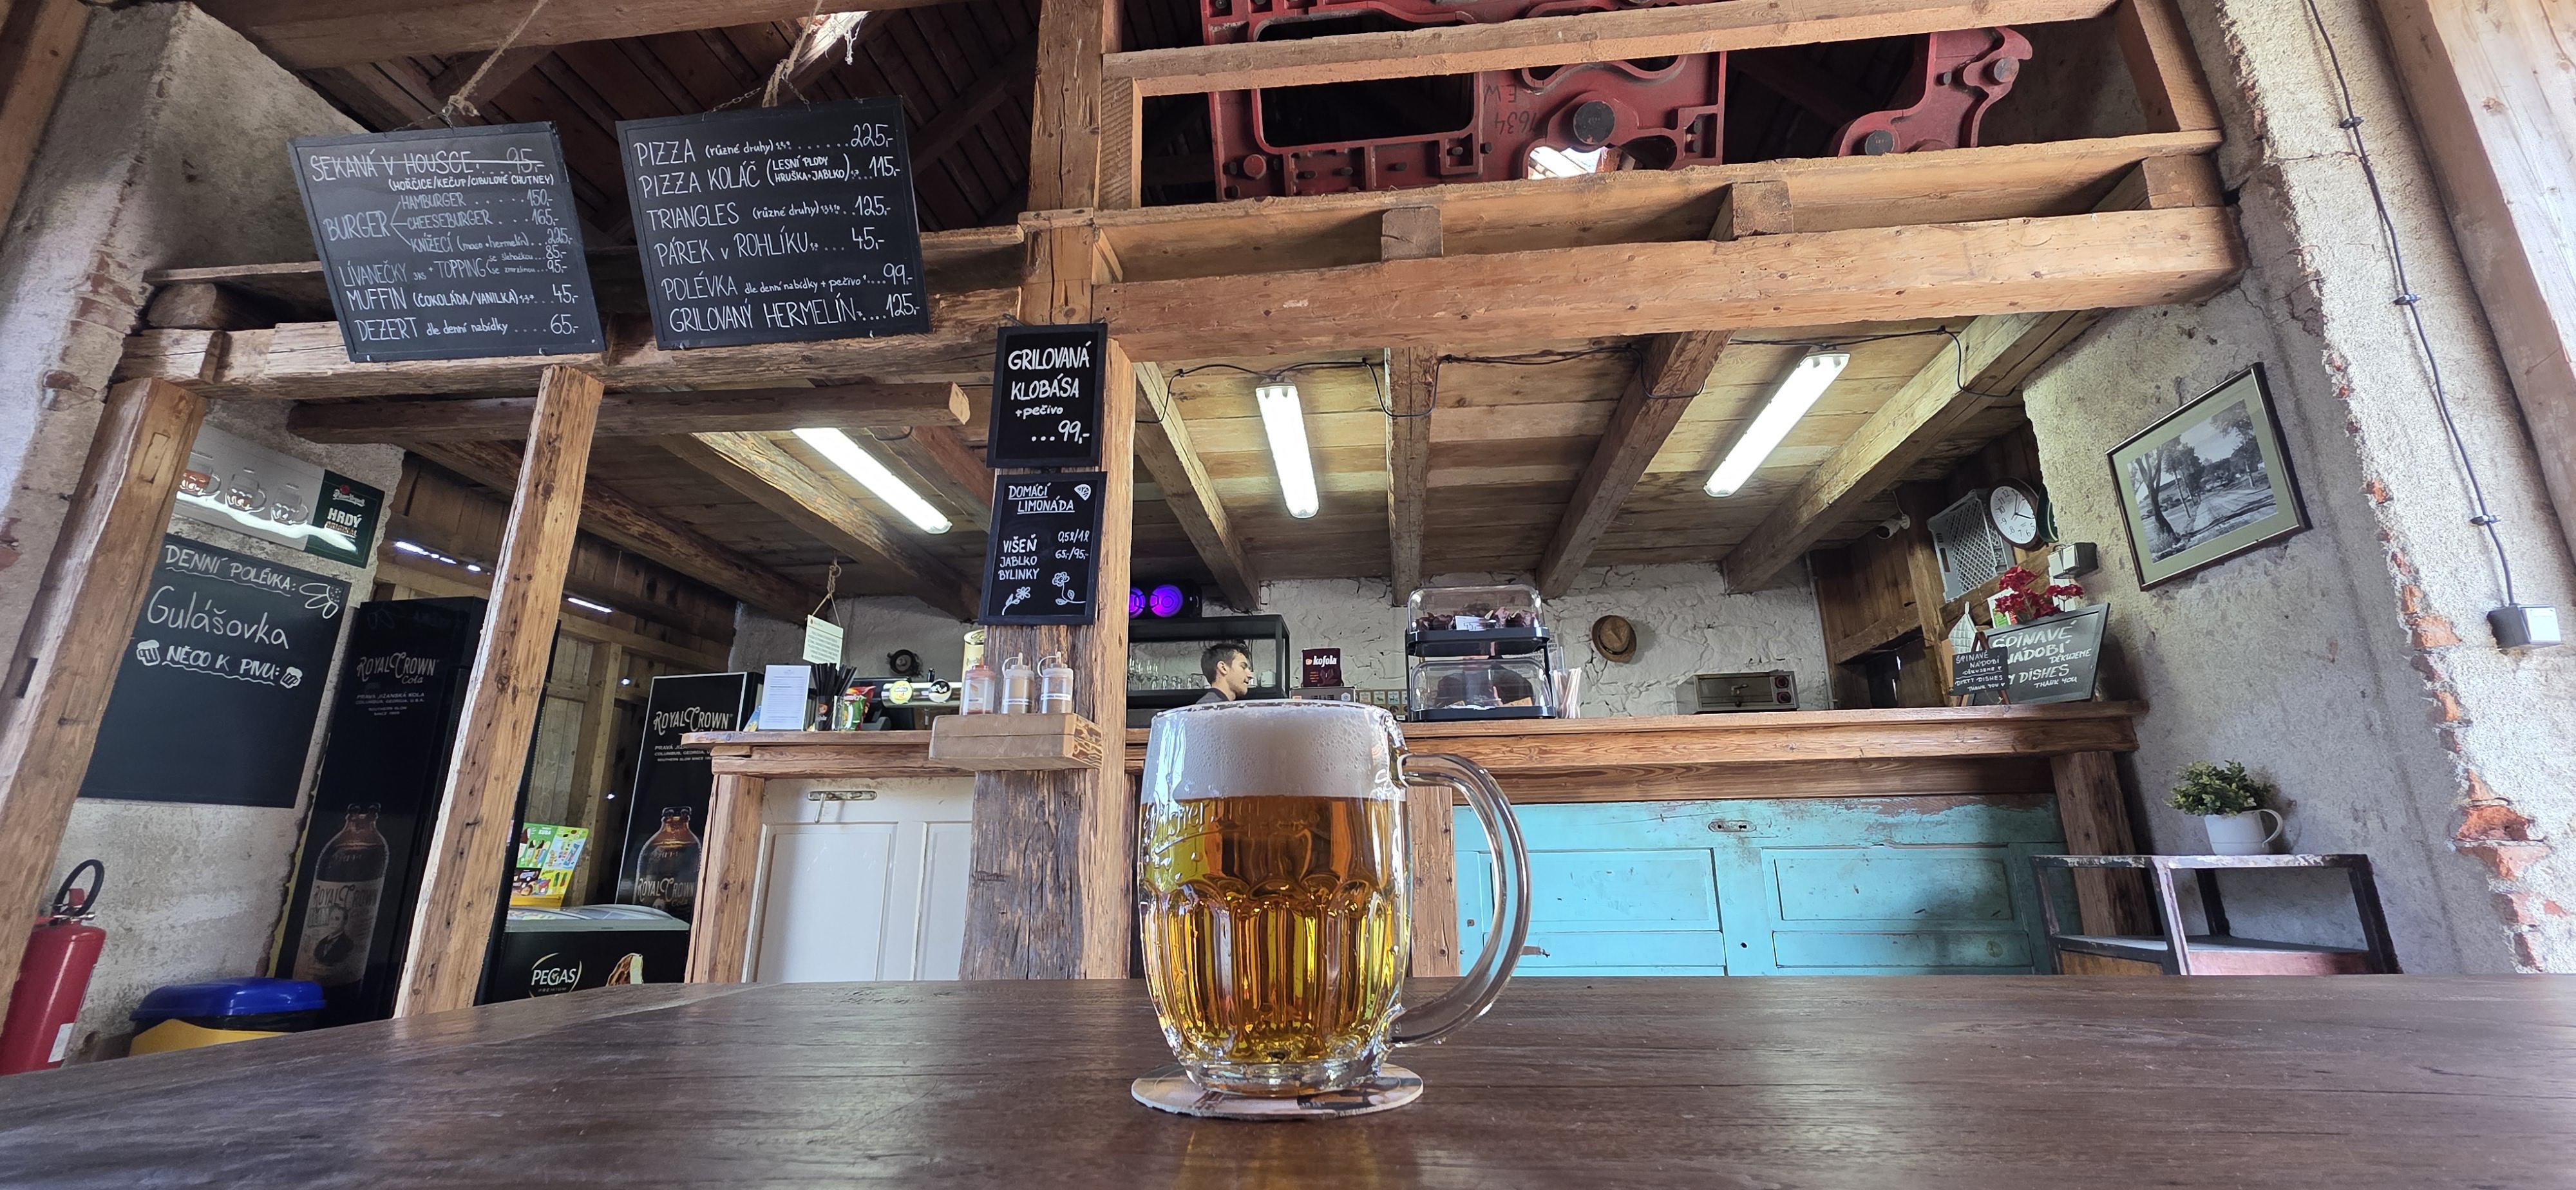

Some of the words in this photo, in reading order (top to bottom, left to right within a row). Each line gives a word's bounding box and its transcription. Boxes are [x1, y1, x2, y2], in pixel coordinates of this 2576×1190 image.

[634, 138, 696, 167] PIZZA
[705, 144, 740, 158] (různé
[743, 138, 773, 155] druhy)
[851, 123, 893, 147] 225,-
[310, 149, 378, 182] SEKANÁ
[381, 155, 393, 176] V
[404, 151, 473, 175] HOUSCE
[638, 171, 701, 198] PIZZA
[707, 160, 760, 191] KOLÁČ
[802, 156, 828, 167] PLODY
[869, 156, 900, 176] 115,-
[511, 174, 554, 185] CHUTNEY)
[401, 193, 466, 210] HAMBURGER
[527, 189, 553, 207] 150,-
[646, 202, 739, 231] TRIANGLES
[752, 206, 786, 220] (různé
[788, 200, 819, 216] druhy)
[855, 195, 891, 216] 125,-
[323, 211, 390, 241] BURGER
[407, 209, 493, 230] CHEESEBURGER
[532, 209, 559, 226] 165,-
[410, 232, 453, 253] KNÍŽECÍ
[457, 236, 483, 251] (maso
[547, 227, 573, 245] 225,-
[545, 244, 567, 259] 85,-
[654, 236, 715, 267] PÁREK
[734, 225, 808, 257] ROHLÍKU
[851, 227, 885, 250] 45,-
[338, 260, 408, 287] LÍVANEČKY
[433, 259, 486, 278] TOPPING
[547, 260, 567, 274] 95,-
[661, 270, 738, 301] POLÉVKA
[744, 282, 758, 294] dle
[760, 281, 782, 293] denní
[783, 278, 818, 293] nabídky
[828, 276, 861, 292] pečivo
[883, 263, 913, 285] 99,-
[346, 287, 407, 311] MUFFIN
[413, 288, 518, 307] (ČOKOLÁDA/VANILKA)
[552, 283, 578, 304] 45,-
[669, 298, 753, 332] GRILOVANÝ
[763, 292, 856, 328] HERMELÍN
[886, 293, 920, 317] 125,-
[354, 317, 418, 341] DEZERT
[426, 322, 440, 336] dle
[443, 319, 467, 334] denní
[471, 317, 508, 335] nabídky
[550, 314, 579, 335] 65,-
[1008, 341, 1092, 370] GRILOVANÁ
[1010, 373, 1079, 401] KLOBÁSA
[1009, 482, 1051, 499] DOMÁCÍ
[1018, 495, 1074, 513] LIMONÁDA
[327, 507, 362, 528] HRDÝ
[1003, 533, 1037, 553] VIŠEŇ
[166, 545, 229, 574] DENNÍ
[230, 562, 296, 590] POLÉVKA:
[998, 567, 1039, 580] BYLINKY
[999, 556, 1037, 567] JABLKO
[147, 585, 289, 649] Gulášovka
[166, 645, 211, 666] NĚCO
[214, 654, 231, 672] K
[240, 658, 281, 680] PIVU:
[357, 656, 390, 682] ROYAL
[390, 652, 436, 678] CROWN
[402, 675, 423, 684] Cola
[2033, 680, 2059, 688] THANK
[653, 711, 685, 735] ROYAL
[685, 706, 729, 732] CROWN
[638, 878, 661, 902] ROYAL
[660, 877, 695, 902] CROWN
[531, 968, 576, 985] PEGAS
